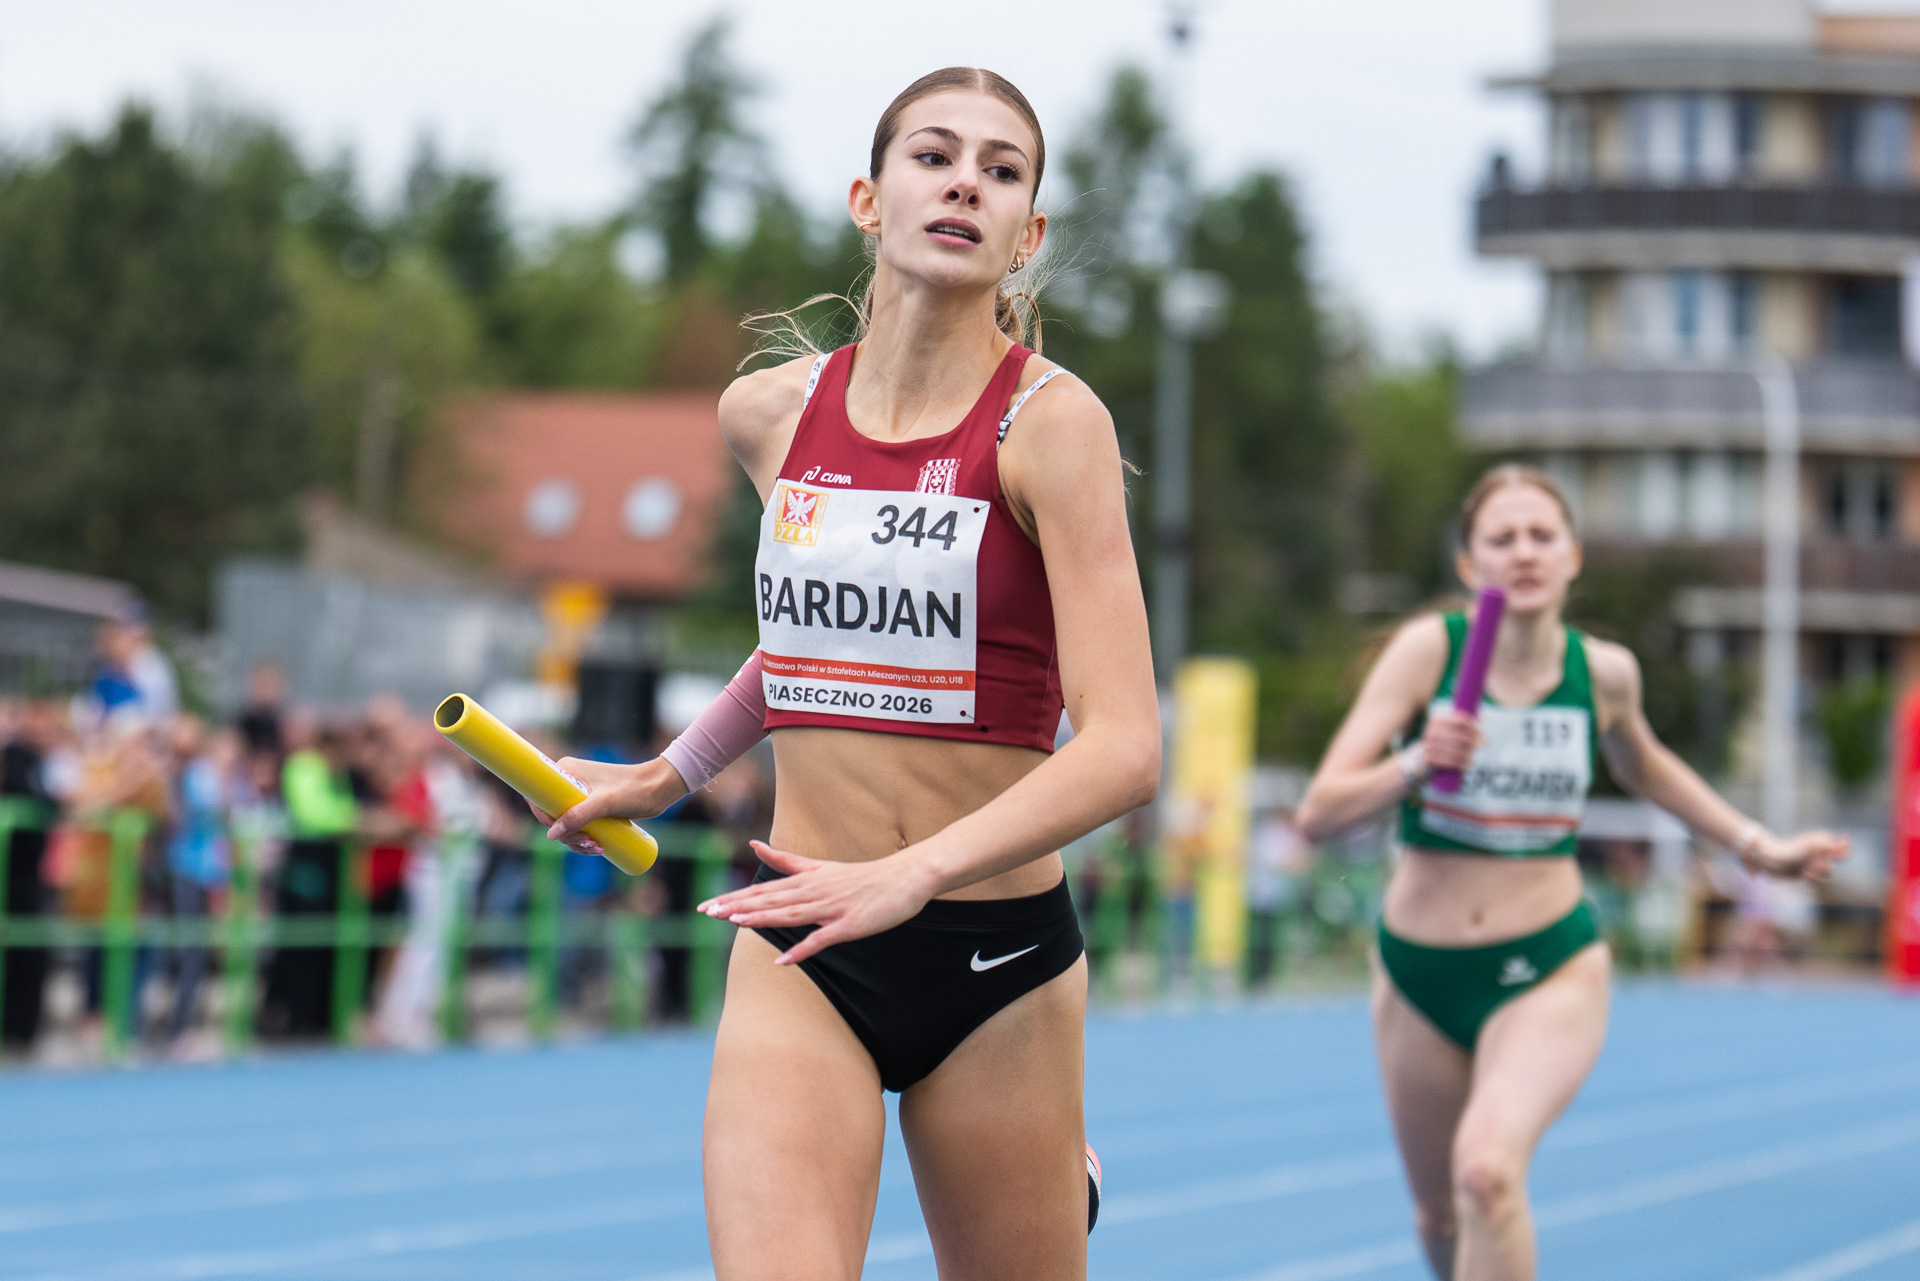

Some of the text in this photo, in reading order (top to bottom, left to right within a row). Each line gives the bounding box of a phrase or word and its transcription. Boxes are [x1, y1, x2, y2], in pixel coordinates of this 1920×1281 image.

[820, 472, 852, 486] CUNA
[775, 523, 814, 544] PZLA
[871, 504, 958, 551] 344
[760, 572, 961, 639] BARDJAN
[797, 663, 818, 672] Polski
[827, 666, 866, 678] Sztafetach
[867, 670, 910, 682] Mieszanych
[911, 674, 928, 684] U23,
[929, 676, 948, 685] U20,
[949, 676, 963, 684] U18
[769, 683, 933, 714] PIASECZNO 2026
